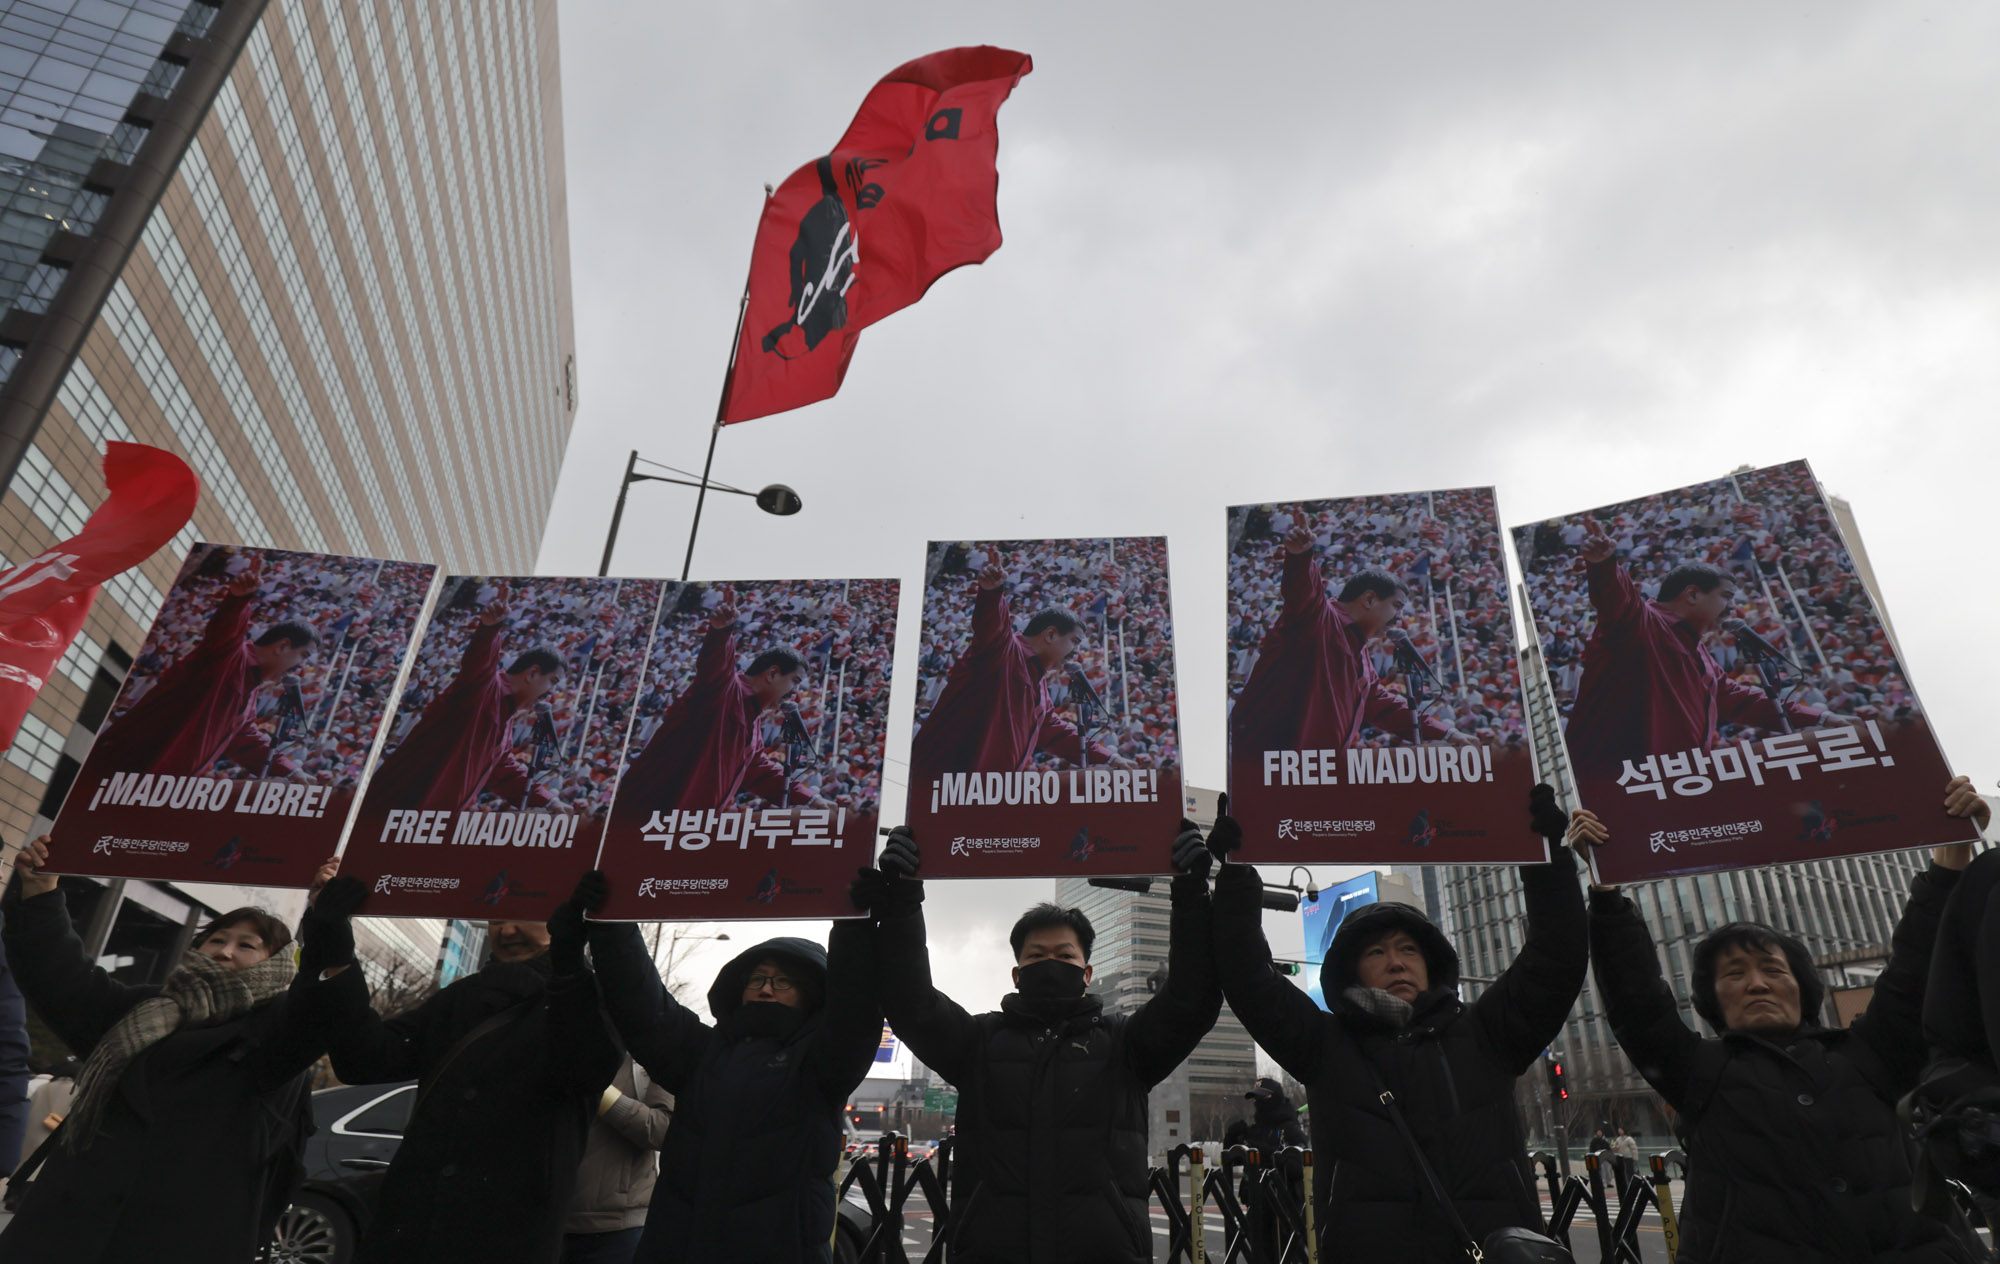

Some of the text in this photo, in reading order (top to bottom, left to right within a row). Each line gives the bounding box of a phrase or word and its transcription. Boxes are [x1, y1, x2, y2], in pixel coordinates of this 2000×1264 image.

[1263, 745, 1494, 786] FREE MADURO!
[1616, 719, 1895, 800] 석방마두로!
[89, 772, 333, 818] ¡MADURO LIBRE!
[931, 768, 1158, 814] ¡MADURO LIBRE!
[380, 809, 580, 848] FREE MADURO!
[639, 807, 847, 851] 석방마두로!
[1278, 818, 1299, 841] 民
[1294, 819, 1376, 833] 민중민주당(민중당)
[1666, 819, 1763, 843] 민중민주당(민중당)
[92, 835, 114, 856] 民
[950, 836, 970, 857] 民
[967, 837, 1042, 849] 민중민주당(민중당)
[1649, 830, 1676, 853] 民
[374, 874, 392, 895] 民
[638, 877, 657, 899] 民
[1195, 1193, 1204, 1261] POLICE
